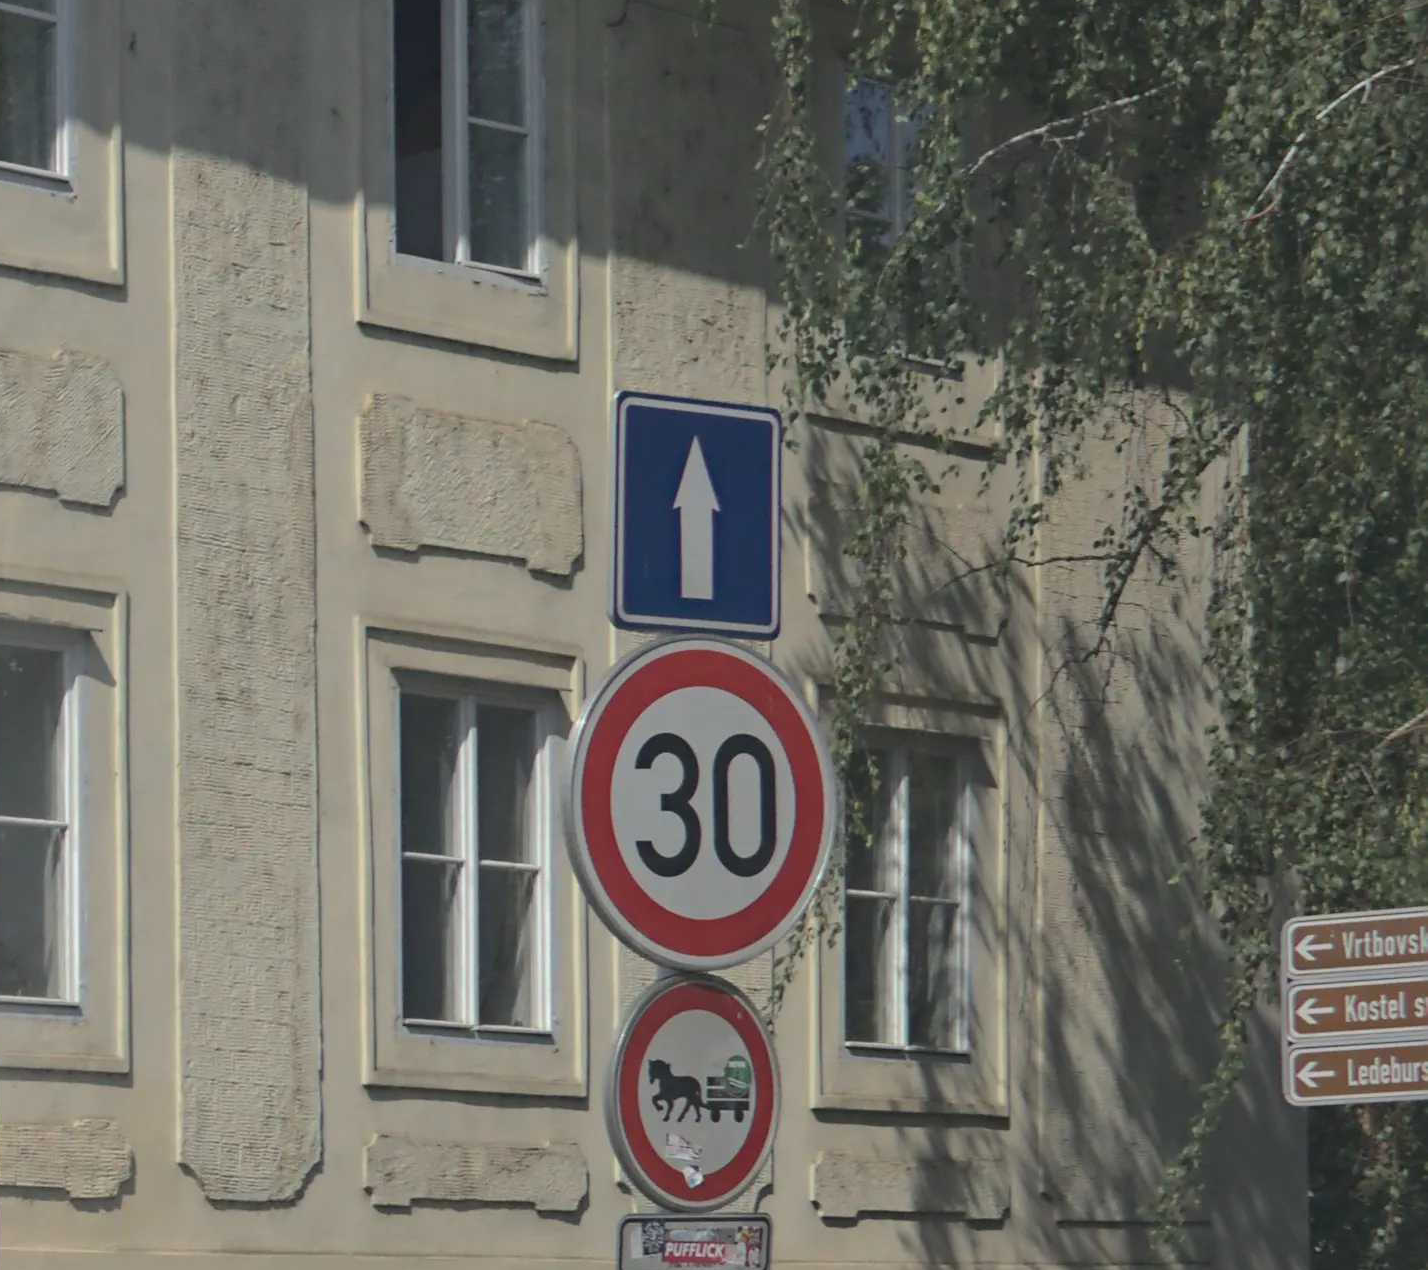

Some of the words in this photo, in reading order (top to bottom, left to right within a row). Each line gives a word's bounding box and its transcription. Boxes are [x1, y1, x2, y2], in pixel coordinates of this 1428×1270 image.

[635, 732, 777, 878] 30
[1344, 992, 1407, 1023] Kostel
[664, 1242, 725, 1259] PUFFLICK
